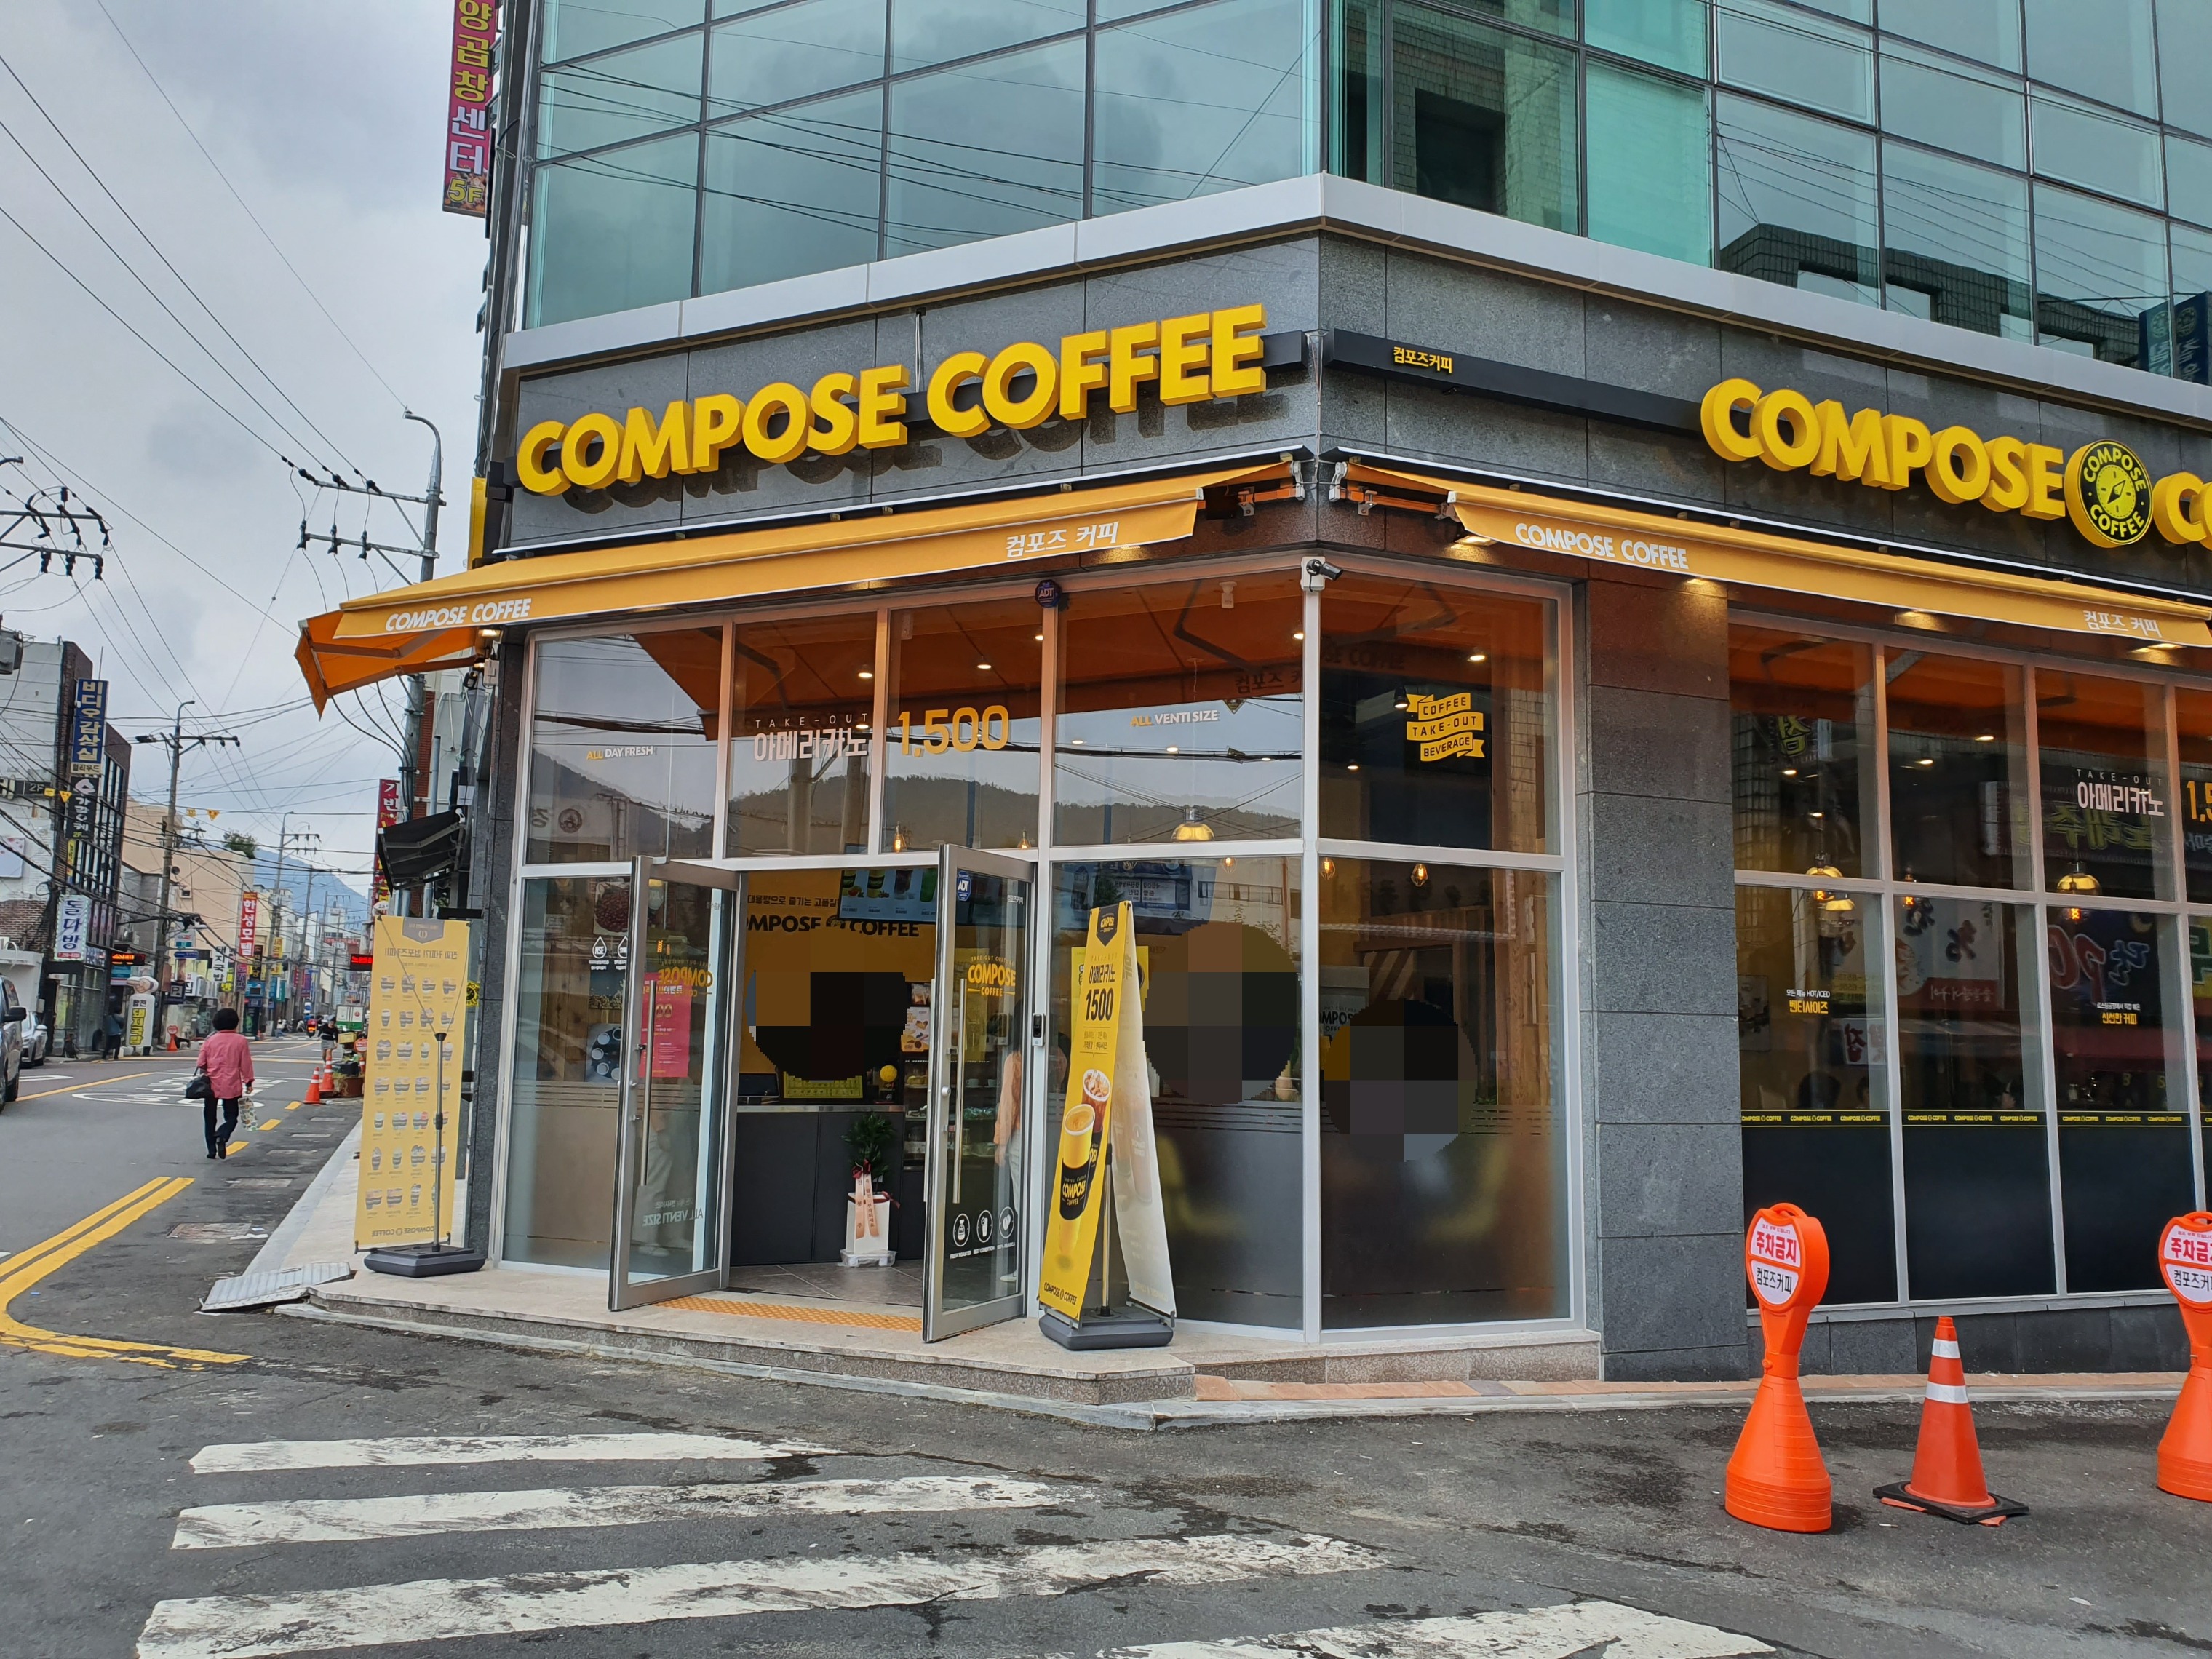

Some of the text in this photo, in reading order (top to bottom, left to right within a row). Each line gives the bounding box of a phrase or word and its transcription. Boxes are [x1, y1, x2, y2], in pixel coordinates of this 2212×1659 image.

[448, 178, 483, 203] 5F
[1393, 346, 1453, 374] 컴포즈커피
[517, 303, 1268, 496] COMPOSE COFFEE
[1700, 377, 2066, 520] COMPOSE
[2084, 447, 2147, 492] COMPOSE
[2090, 504, 2145, 538] COFFEE
[1006, 521, 1119, 558] 컴포즈 커피
[1515, 522, 1690, 570] COMPOSE COFFEE
[1038, 587, 1054, 597] ADT
[385, 598, 532, 632] COMPOSE COFFEE
[2082, 610, 2163, 638] 컴포즈 커피
[1130, 709, 1220, 726] ALL VENTI SIZE
[1423, 696, 1467, 715] COFFEE
[755, 712, 868, 728] TAKE-OUT
[897, 704, 1009, 757] 1,500
[1412, 716, 1476, 736] TAKE-OUT
[586, 745, 654, 760] ALL DAY FRESH
[754, 728, 868, 761] 아메리카노
[1423, 736, 1470, 757] BEVERAGE
[2077, 768, 2163, 787] TAKE-OUT
[2077, 781, 2165, 816] 아메리카노
[958, 880, 969, 891] ADT
[814, 898, 839, 907] 고품질
[239, 899, 256, 955] 한성모텔
[747, 914, 822, 932] MPOSE
[968, 963, 1017, 987] COMPOSE
[981, 986, 1003, 996] COFFEE
[1086, 989, 1114, 1022] 1500
[1789, 1000, 1829, 1014] 벤티사이즈
[1062, 1180, 1086, 1199] COMPOSE
[1757, 1230, 1797, 1263] 주차금지
[2171, 1237, 2212, 1263] 주차금
[1043, 1281, 1078, 1305] COMPOSE COFFEE
[1757, 1267, 1792, 1294] 컴포즈커피
[2174, 1270, 2212, 1292] 컴포즈커
